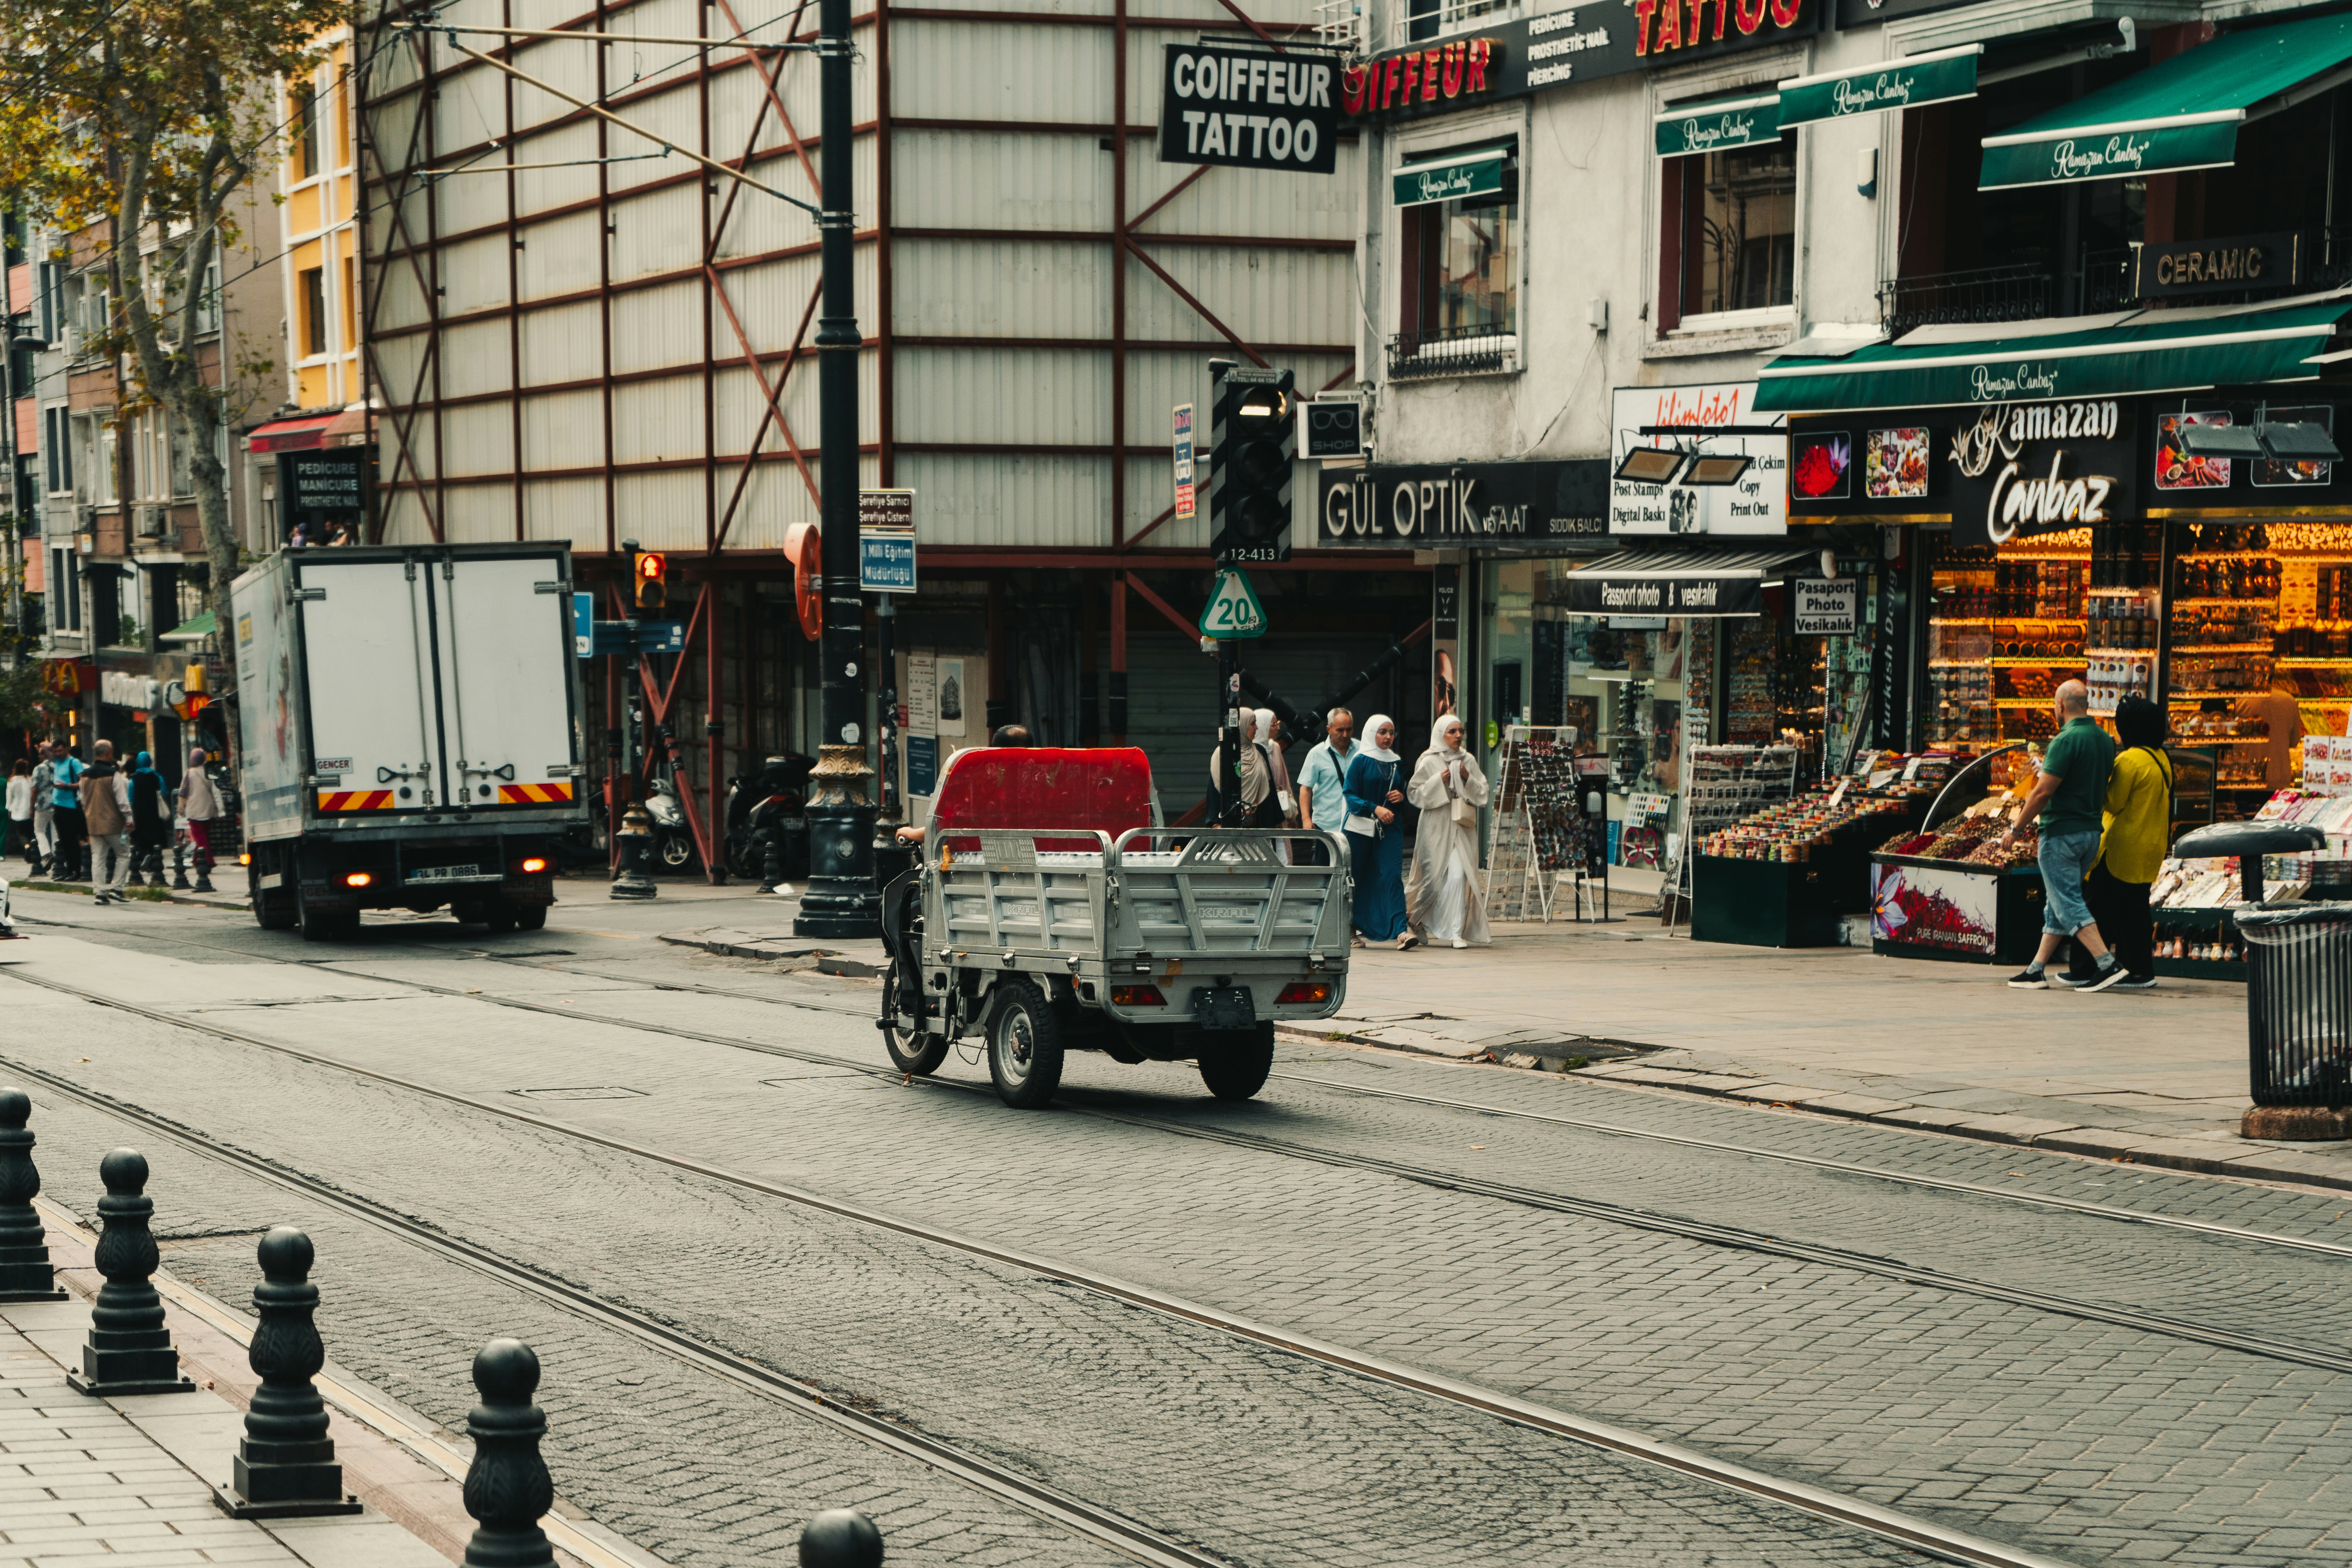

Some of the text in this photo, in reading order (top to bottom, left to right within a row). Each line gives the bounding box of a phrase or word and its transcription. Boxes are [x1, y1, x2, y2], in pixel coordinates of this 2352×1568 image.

[1529, 12, 1576, 36] PEDİCURE
[1528, 27, 1610, 61] PROSTHETİC NAİL
[1174, 53, 1330, 108] COIFFEUR
[1343, 38, 1490, 115] OIFFEUR
[1528, 62, 1572, 87] PİERCİNG
[1183, 110, 1318, 162] TATTOO
[2158, 247, 2262, 285] CERAMIC
[1313, 441, 1354, 450] SHOP
[1759, 456, 1785, 474] Çekim
[1614, 482, 1664, 500] Post Stamps
[1740, 479, 1760, 496] Copy
[1987, 449, 2111, 544] Canbaz
[1326, 474, 1383, 536] GÜL
[1393, 468, 1479, 536] OPTİK
[1489, 505, 1528, 535] SAAT
[1731, 501, 1769, 516] Print Out
[1613, 505, 1666, 526] Digital Baskı
[885, 544, 911, 561] Eğitim
[1230, 548, 1275, 561] 12-413
[865, 566, 910, 584] Müdürlüğü
[1602, 582, 1636, 607] Passport
[1668, 583, 1675, 606] &
[1797, 581, 1855, 596] Pasaport
[1218, 598, 1250, 625] 20
[1806, 598, 1846, 611] Photo
[1797, 617, 1853, 632] Vesikalık
[1881, 646, 1893, 739] Turkish
[317, 759, 350, 770] GENCER
[434, 868, 447, 877] PR
[1007, 904, 1039, 916] KRAL
[1198, 907, 1255, 918] KRAL
[1916, 927, 1988, 946] PURE IRANIAN SAFFRON
